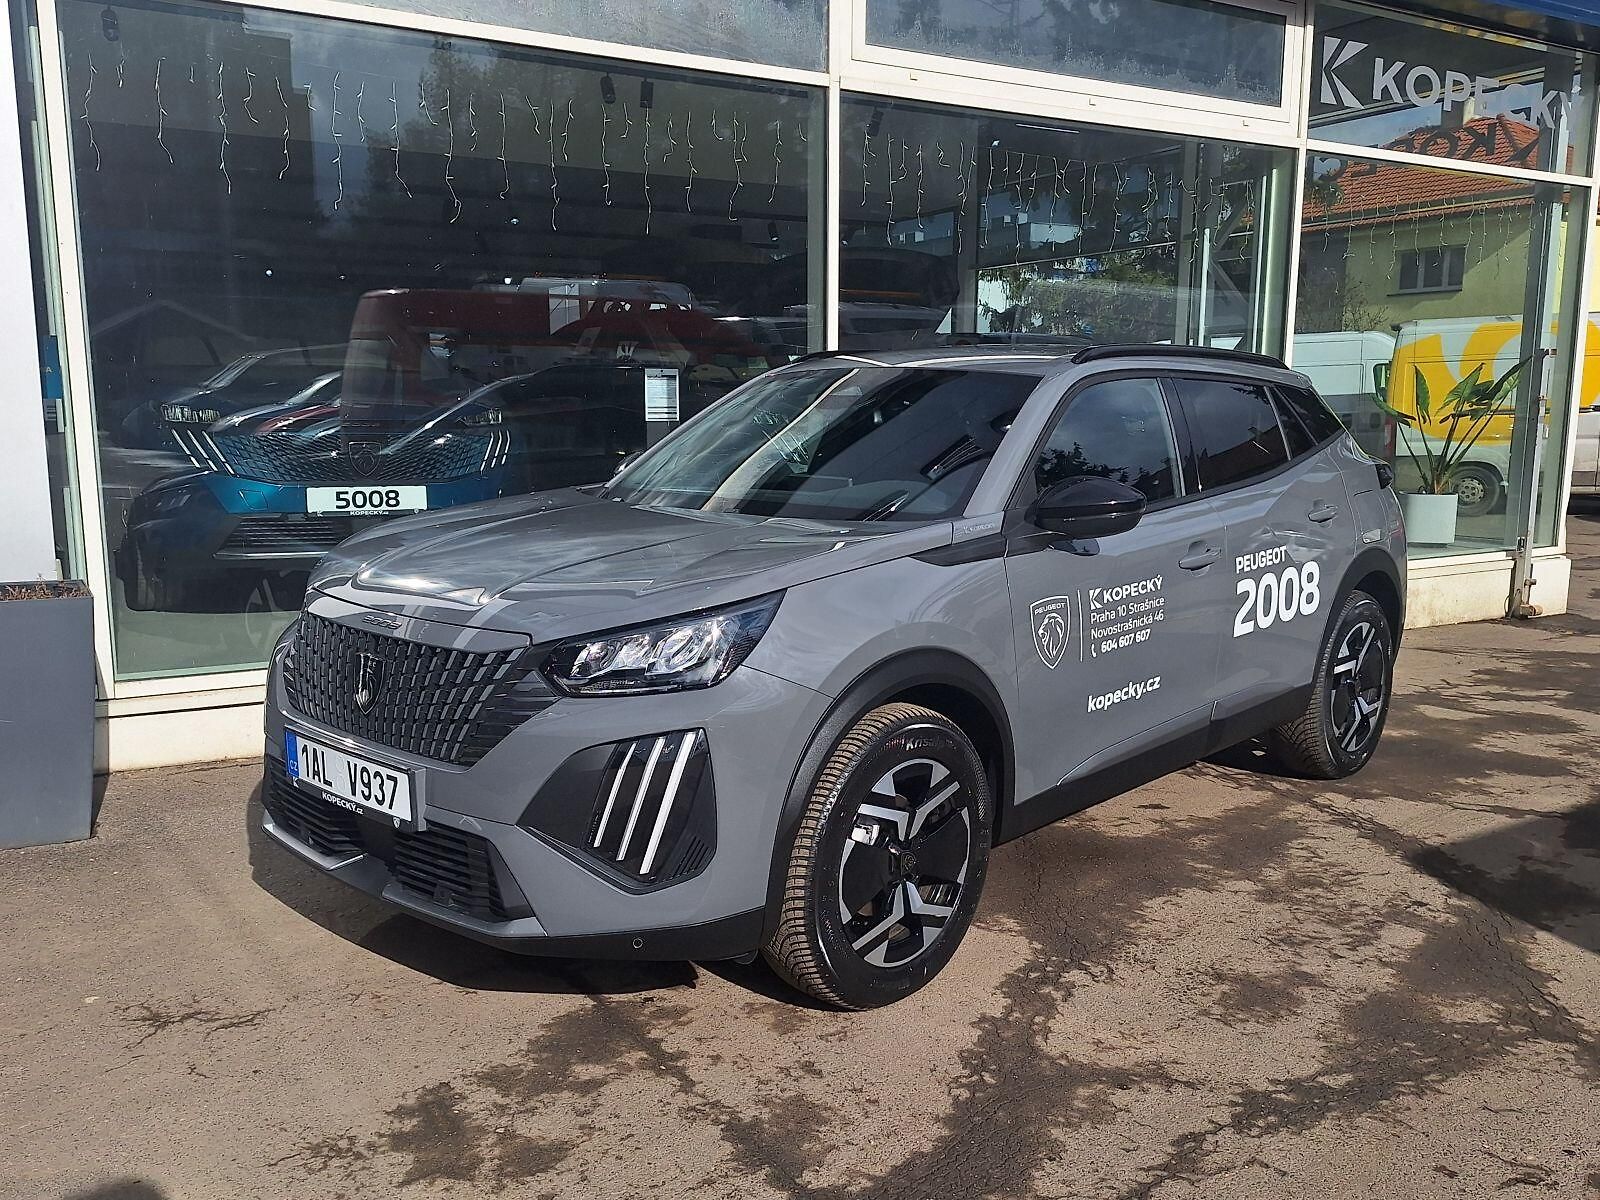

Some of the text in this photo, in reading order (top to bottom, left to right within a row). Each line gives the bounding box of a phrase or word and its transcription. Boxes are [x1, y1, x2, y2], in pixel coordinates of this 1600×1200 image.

[335, 490, 400, 509] 5008
[1235, 545, 1287, 574] PEUGEOT
[1104, 575, 1162, 603] KOPECKÝ
[1233, 560, 1321, 638] 2008
[1034, 602, 1066, 615] PEUGEOT
[1090, 597, 1164, 624] Praha 10 Strašnice
[1092, 609, 1164, 639] Novostrašnická 46
[1101, 629, 1151, 652] 604 607 607
[1087, 676, 1161, 712] kopecky.cz
[289, 743, 399, 810] CZ 1AL V937
